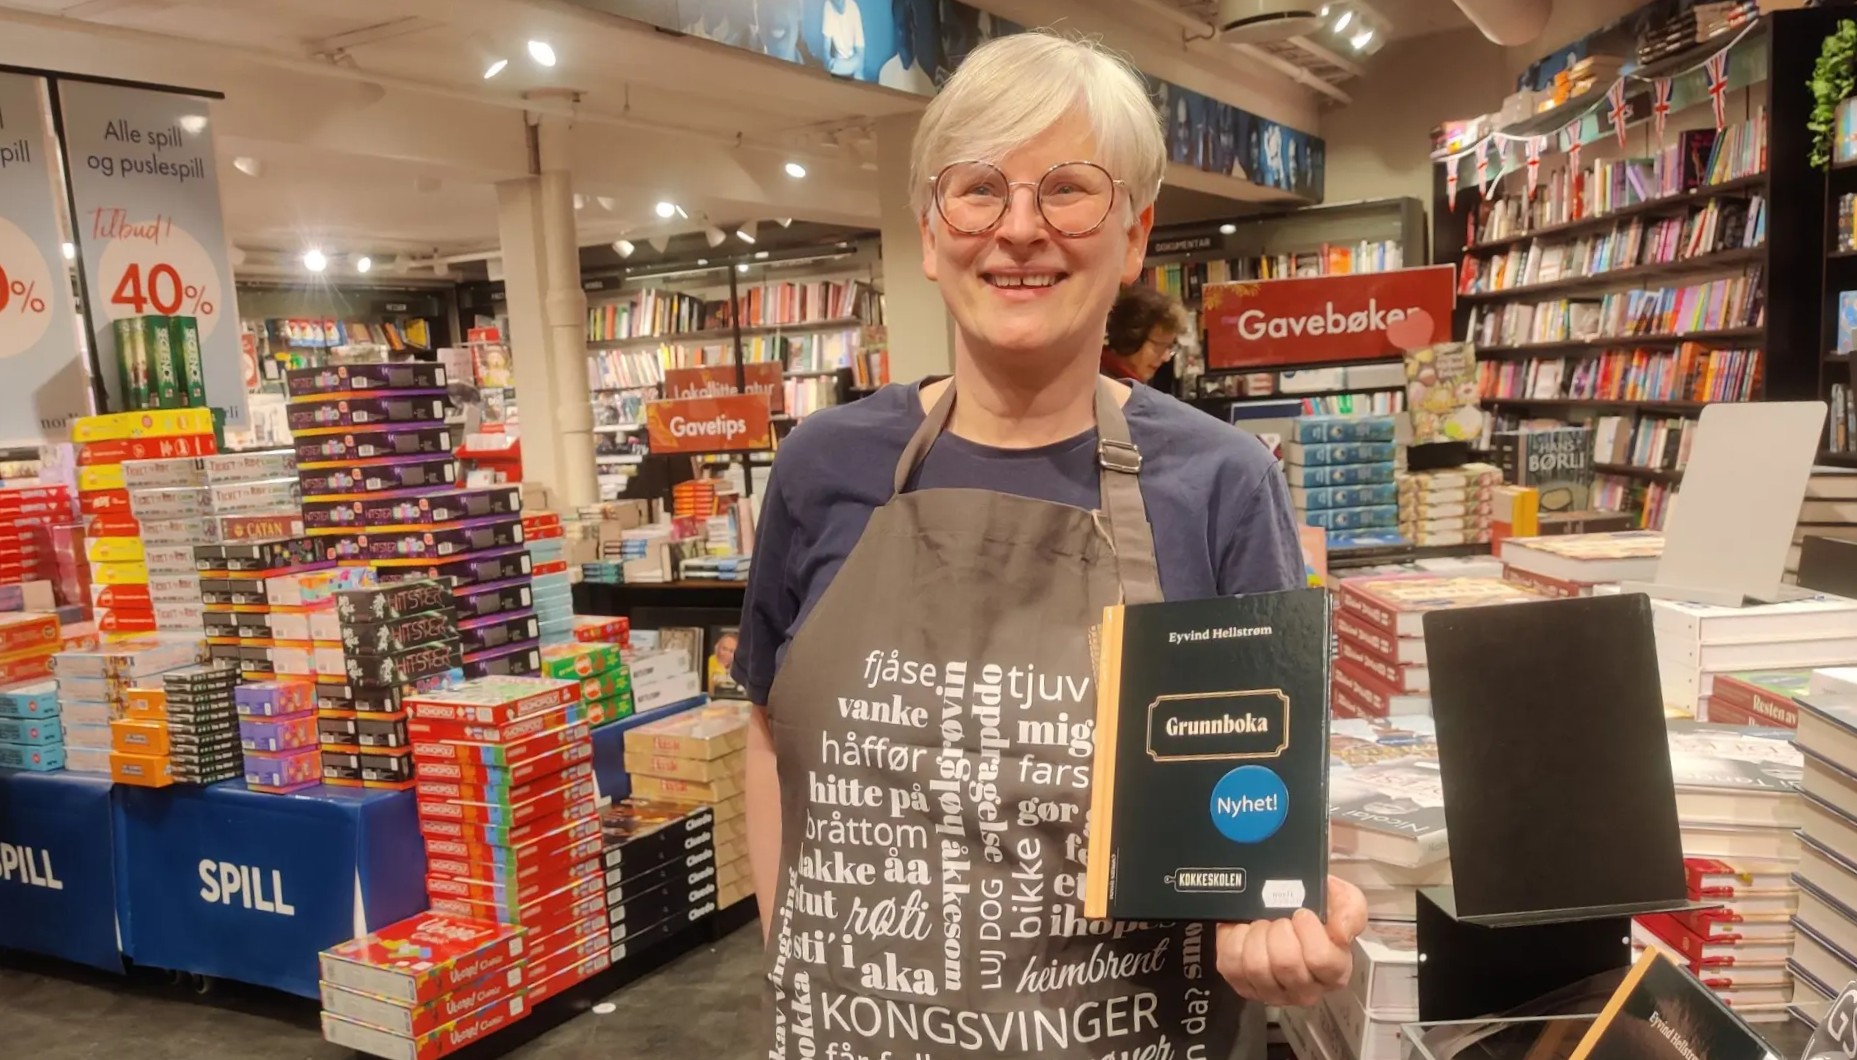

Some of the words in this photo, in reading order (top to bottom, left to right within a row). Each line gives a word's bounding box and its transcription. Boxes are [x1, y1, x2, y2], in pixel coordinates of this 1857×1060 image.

[105, 120, 141, 144] Alle
[147, 127, 183, 154] spill
[87, 155, 113, 177] og
[121, 155, 205, 181] puslespill
[87, 206, 173, 244] Tilbud!
[111, 263, 214, 315] 40%
[669, 416, 746, 440] Gavetips
[1528, 452, 1585, 472] BØRLI
[246, 522, 282, 537] CATAN
[1168, 628, 1210, 645] Eyvind
[1212, 625, 1272, 640] Hellstrøm
[863, 649, 937, 688] fjåse
[1007, 664, 1090, 709] tjuv
[838, 694, 928, 728] vanke
[1166, 713, 1268, 736] Grunnboka
[1753, 694, 1785, 722] Resten
[1785, 710, 1797, 725] av
[822, 730, 927, 773] håffør
[969, 663, 1011, 863] oppdragelse
[1018, 755, 1089, 789] fars
[809, 771, 883, 807] hitte
[889, 783, 930, 818] på
[1018, 797, 1079, 827] gør
[1217, 794, 1278, 818] Nyhet!
[805, 808, 928, 850] bråttom
[1342, 810, 1430, 833] Nicolai
[0, 843, 63, 890] PILL
[884, 846, 932, 886] åa
[1179, 872, 1242, 887] KOKKESKOLEN
[199, 859, 295, 916] SPILL
[1010, 837, 1044, 938] bikke
[941, 840, 971, 991] åkkesom
[980, 879, 1004, 941] DOG
[841, 934, 856, 968] i
[980, 950, 1006, 990] LUJ
[1016, 938, 1170, 994] heimbrent
[860, 952, 939, 996] aka
[821, 992, 1159, 1052] KONGSVINGER
[1649, 1011, 1674, 1041] Eyvind
